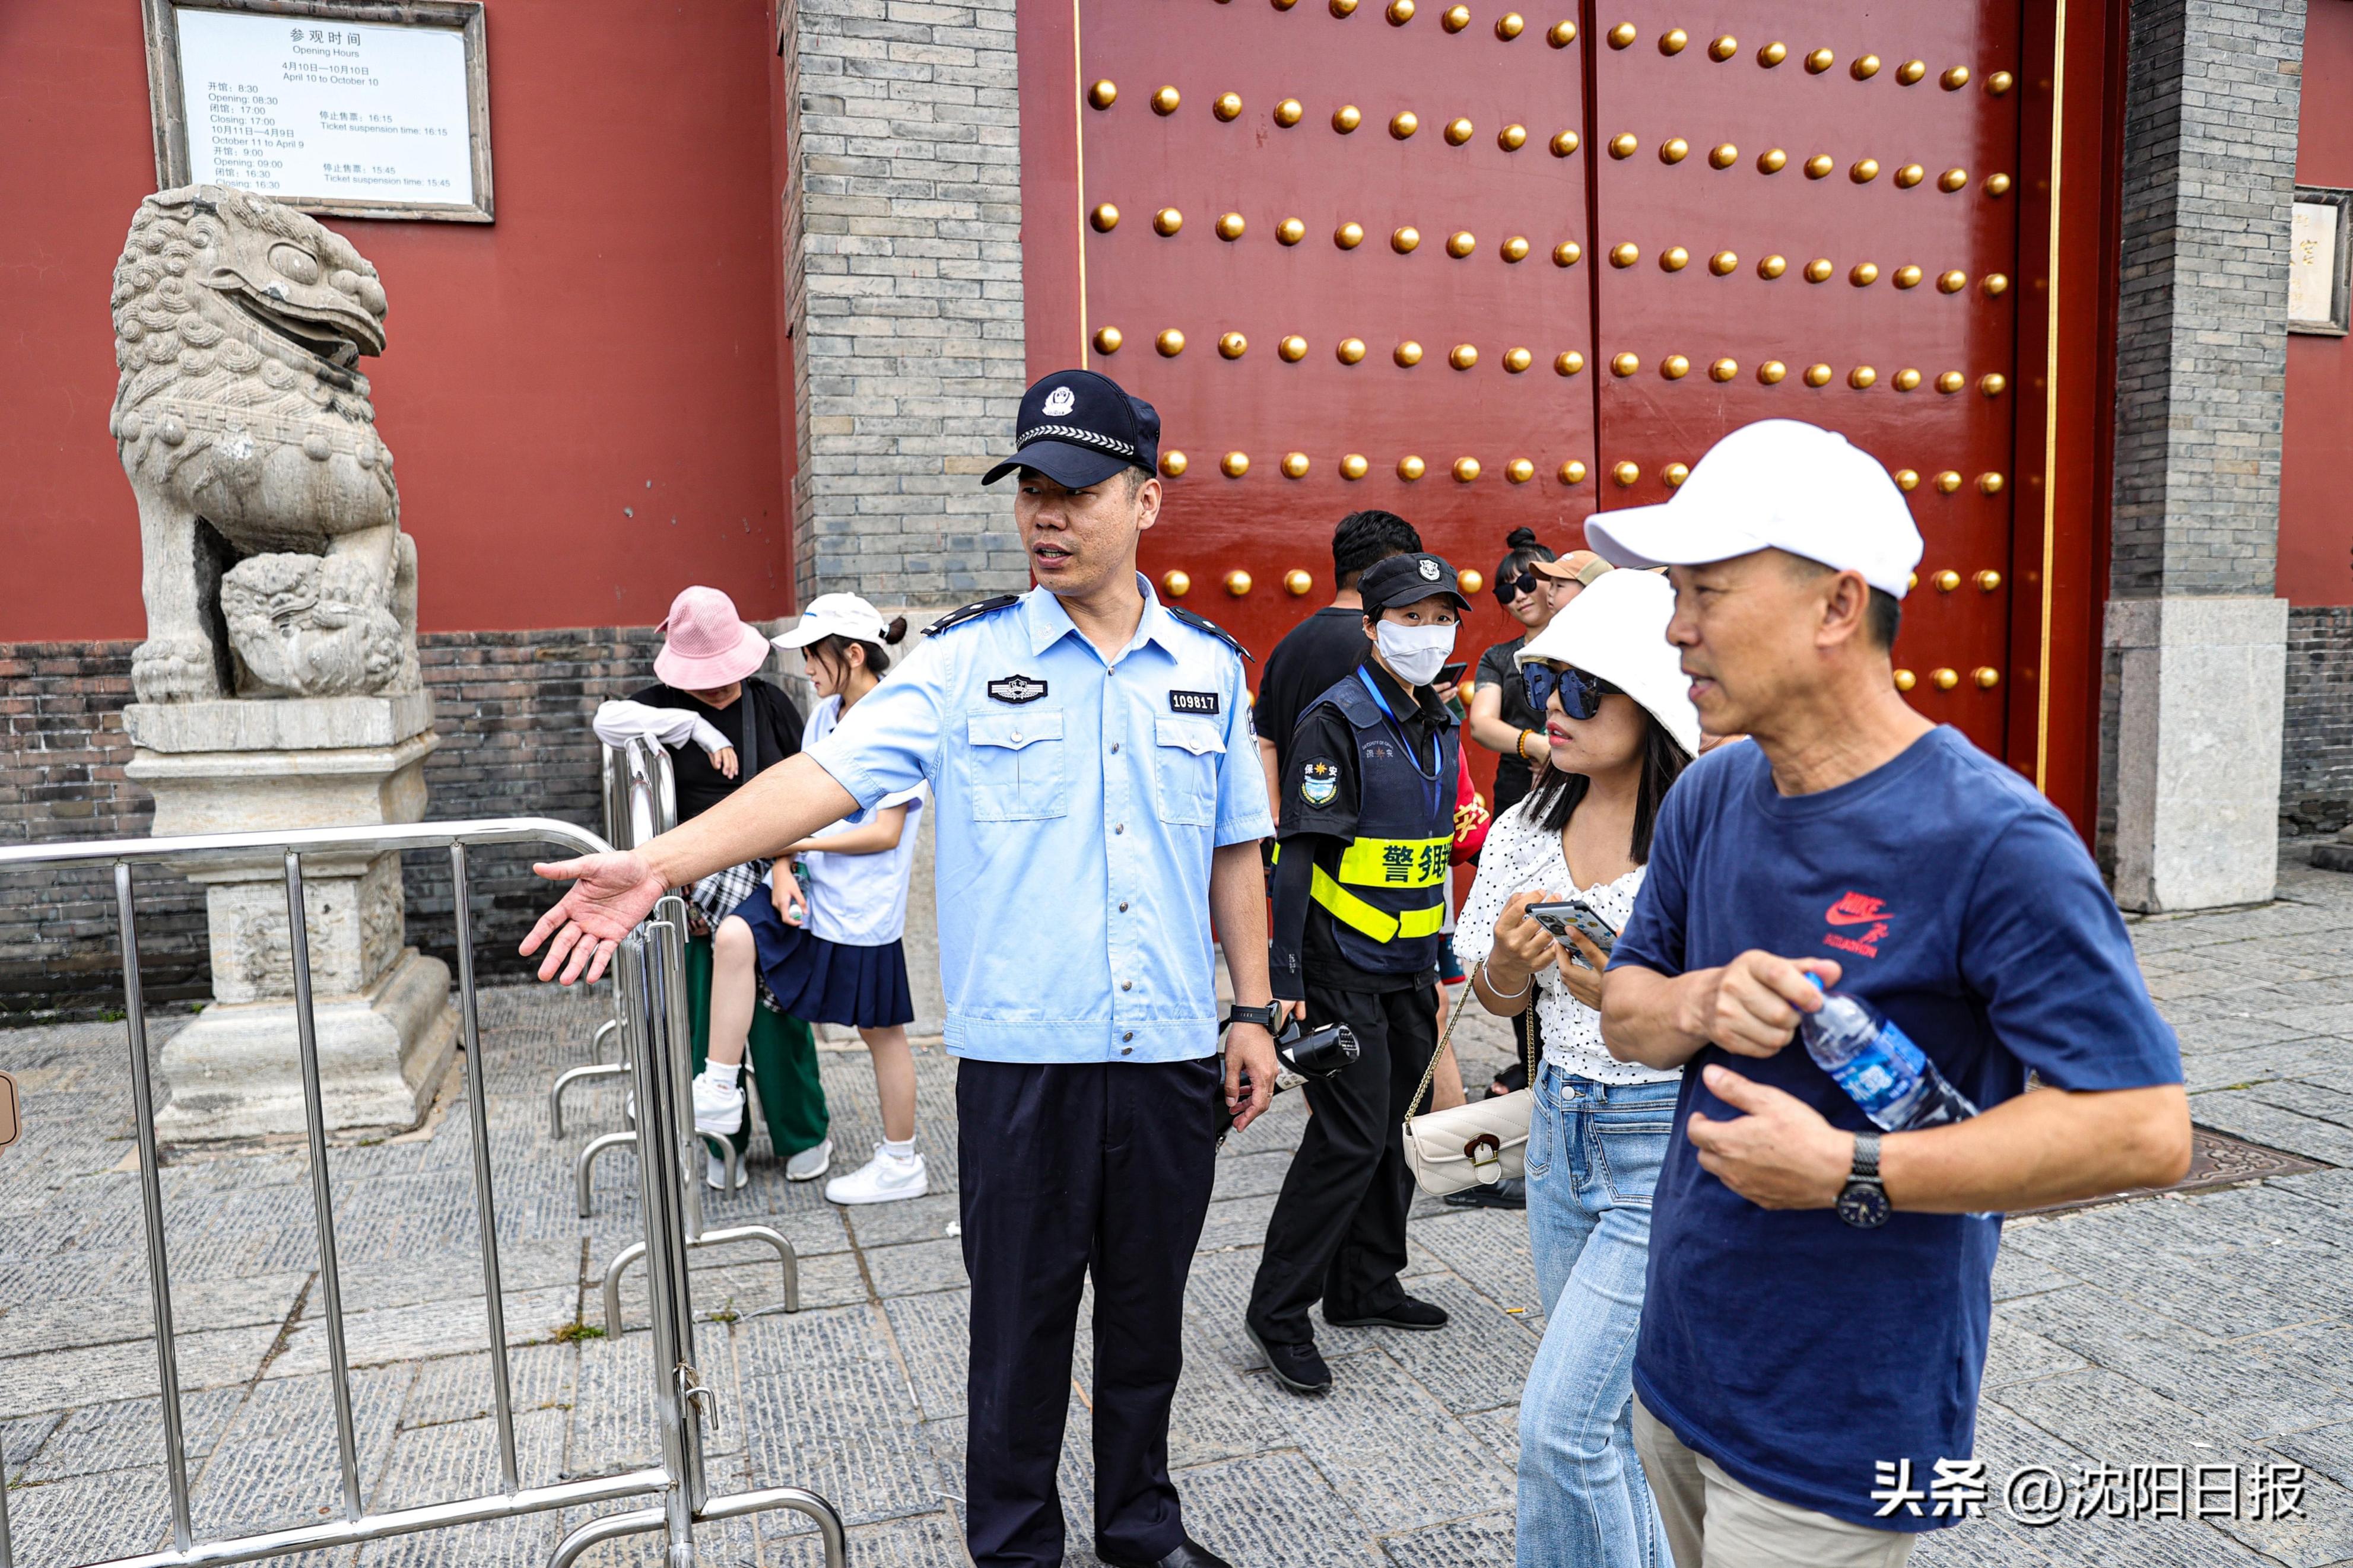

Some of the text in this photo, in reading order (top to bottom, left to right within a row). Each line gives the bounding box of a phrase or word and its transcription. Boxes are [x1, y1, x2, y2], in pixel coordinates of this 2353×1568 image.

[290, 28, 361, 46] 参观时间
[293, 46, 360, 58] Opening Hours
[283, 72, 303, 83] April
[330, 76, 365, 85] October
[208, 93, 278, 105] Opening: 08:30
[210, 115, 275, 126] Closing: 17:00
[320, 122, 448, 136] Ticket suspension time: 16:15
[212, 136, 248, 145] October
[277, 140, 296, 149] April
[214, 157, 283, 169] Opening: 09:00
[256, 181, 280, 189] 16:30
[324, 174, 451, 187] Ticket suspension time: 15:45
[1173, 695, 1215, 710] 109817
